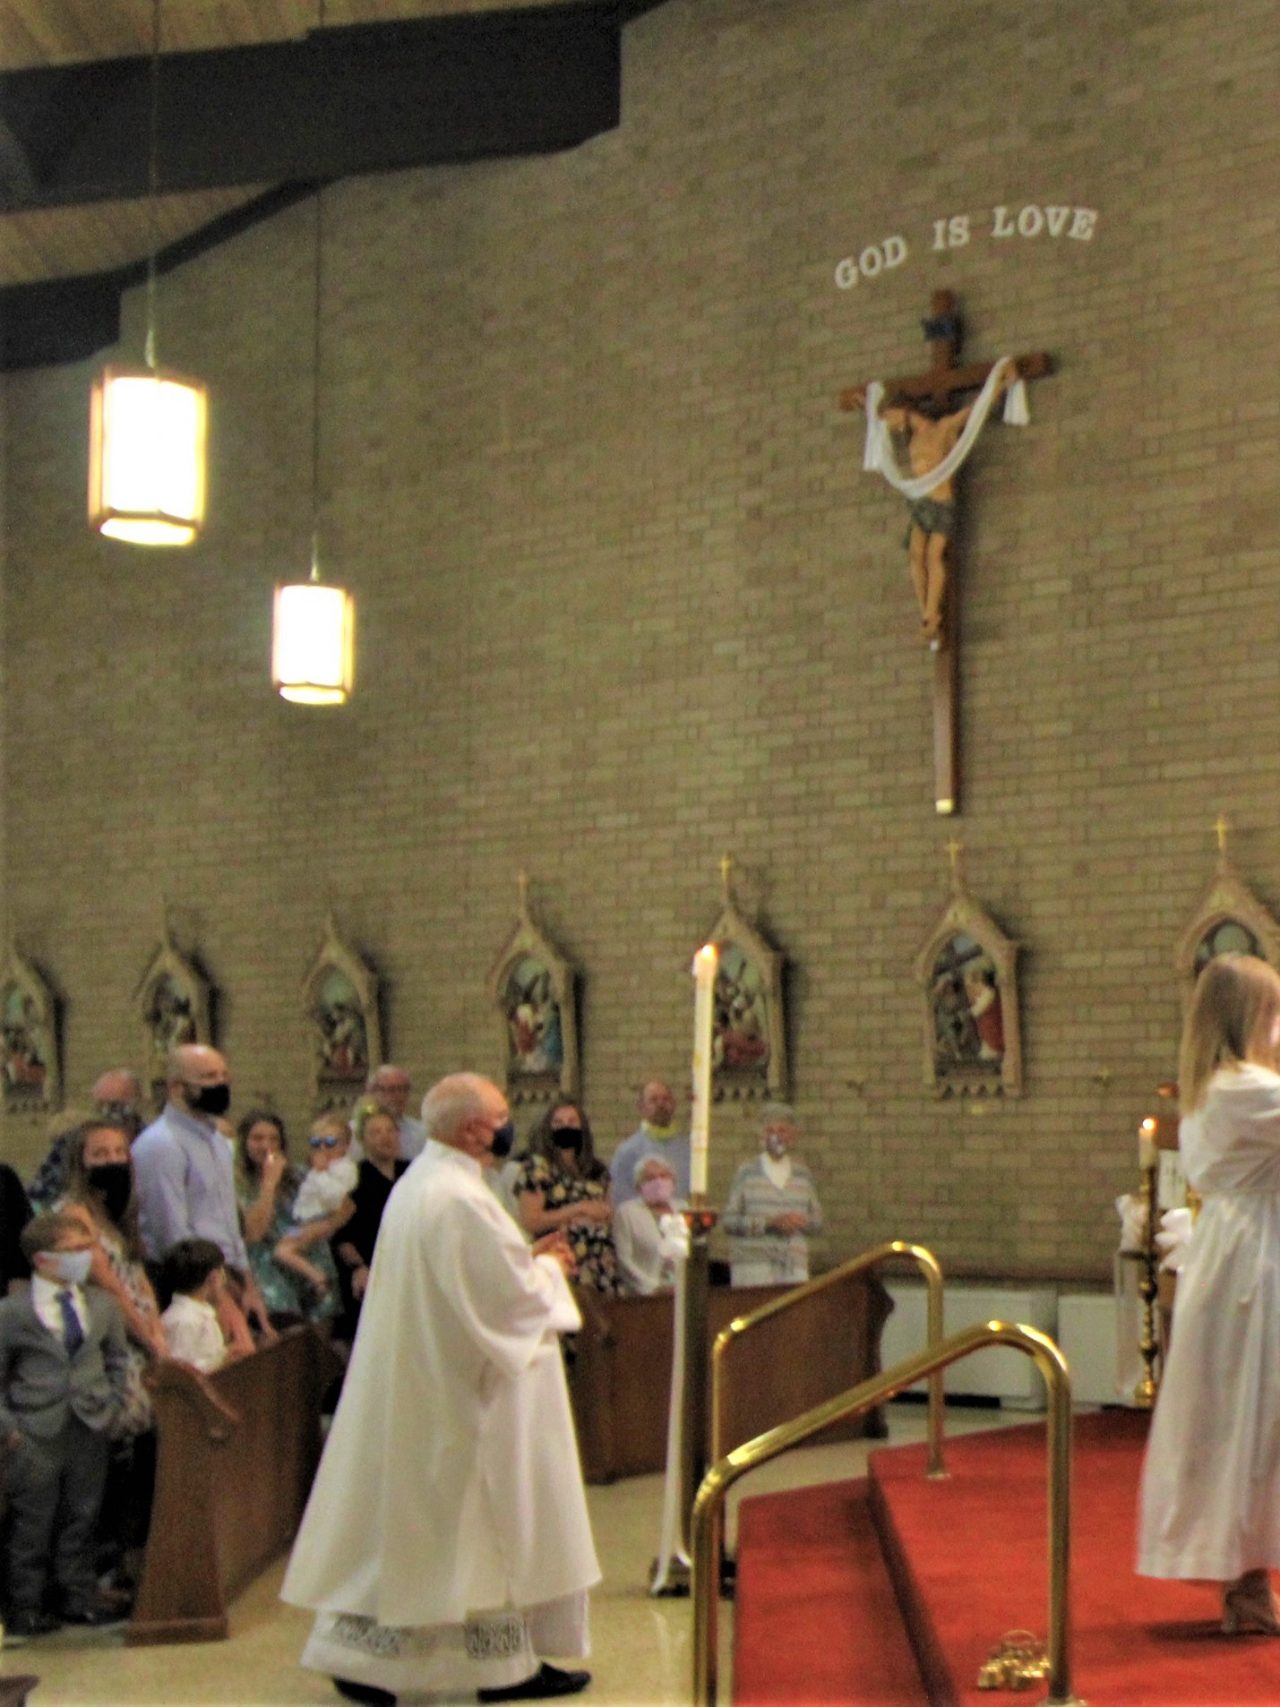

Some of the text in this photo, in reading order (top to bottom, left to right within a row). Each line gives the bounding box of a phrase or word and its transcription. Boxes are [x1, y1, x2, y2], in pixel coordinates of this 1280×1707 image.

[835, 205, 1098, 290] GOD IS LOVE
